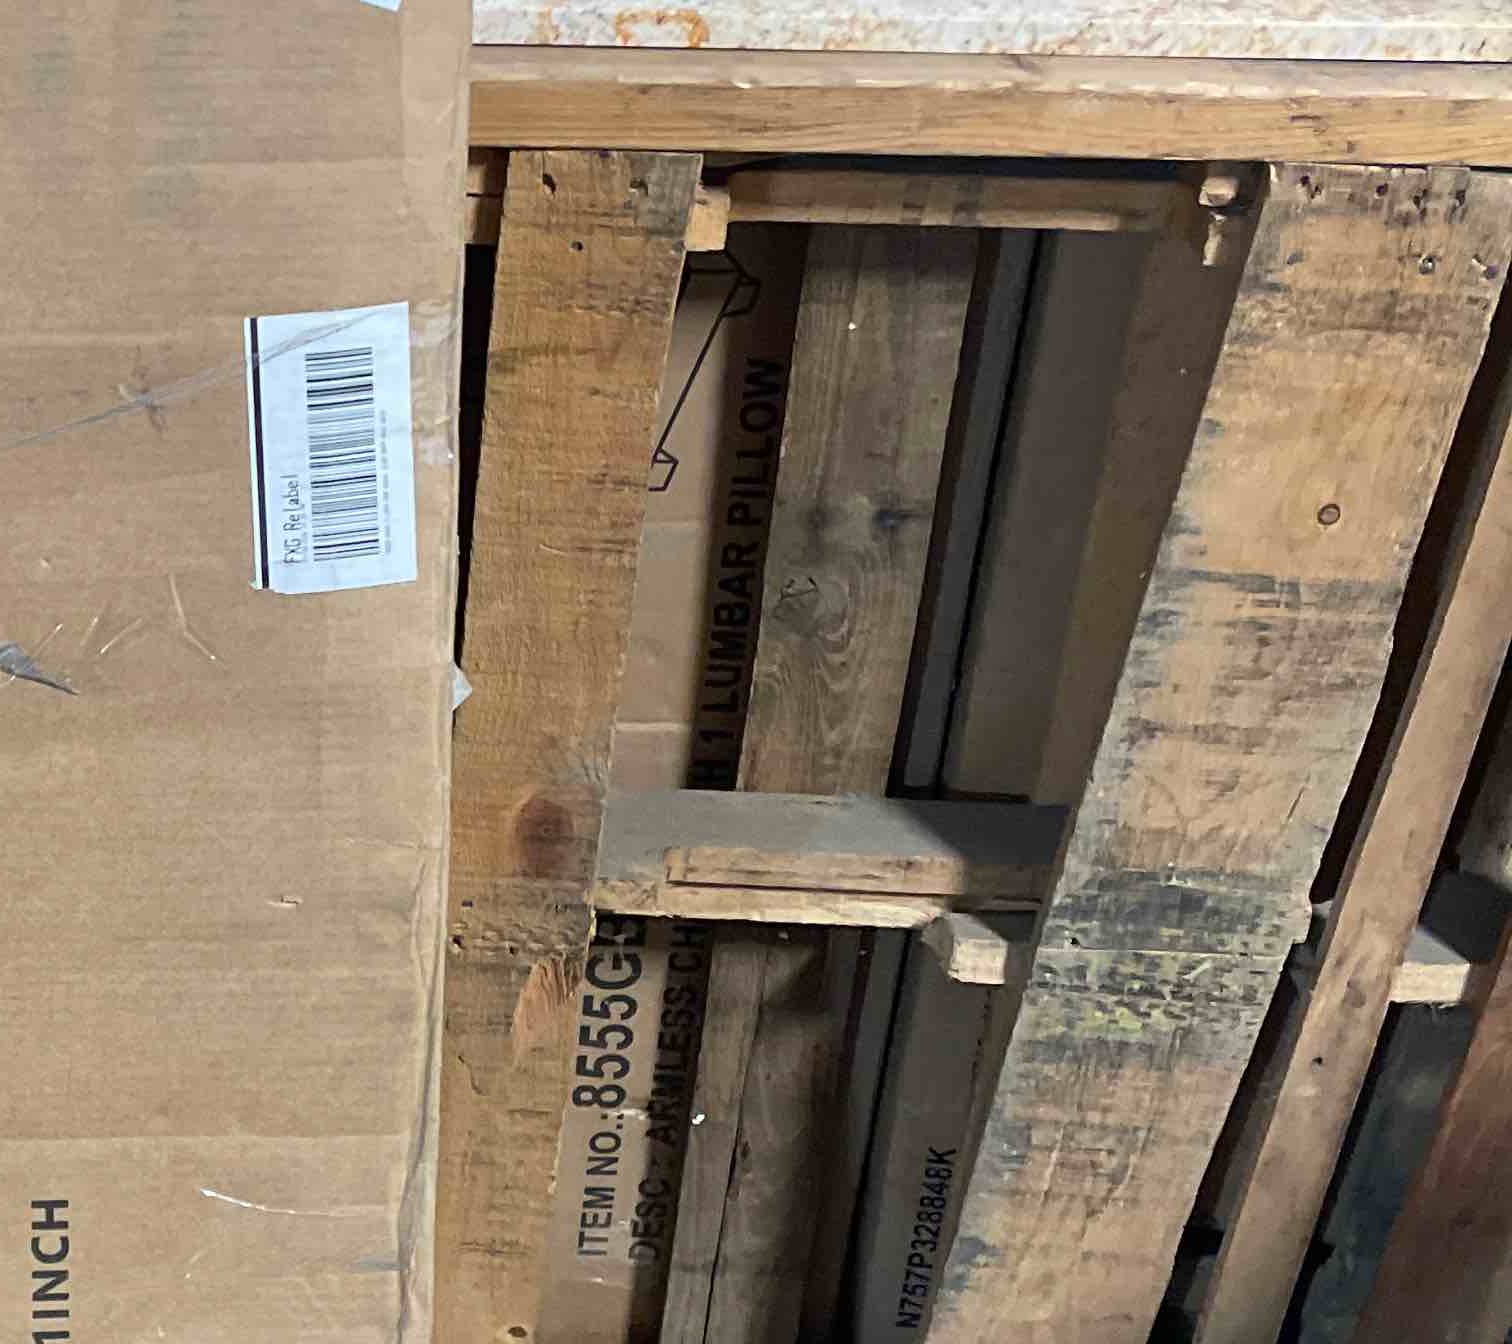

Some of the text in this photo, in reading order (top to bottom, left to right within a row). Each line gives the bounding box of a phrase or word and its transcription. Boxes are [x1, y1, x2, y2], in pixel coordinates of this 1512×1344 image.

[727, 357, 786, 527] PILLOW
[704, 540, 758, 714] LUMBAR
[645, 984, 698, 1147] ARMLESS
[577, 1186, 618, 1257] ITEM
[628, 1176, 672, 1264] DESC
